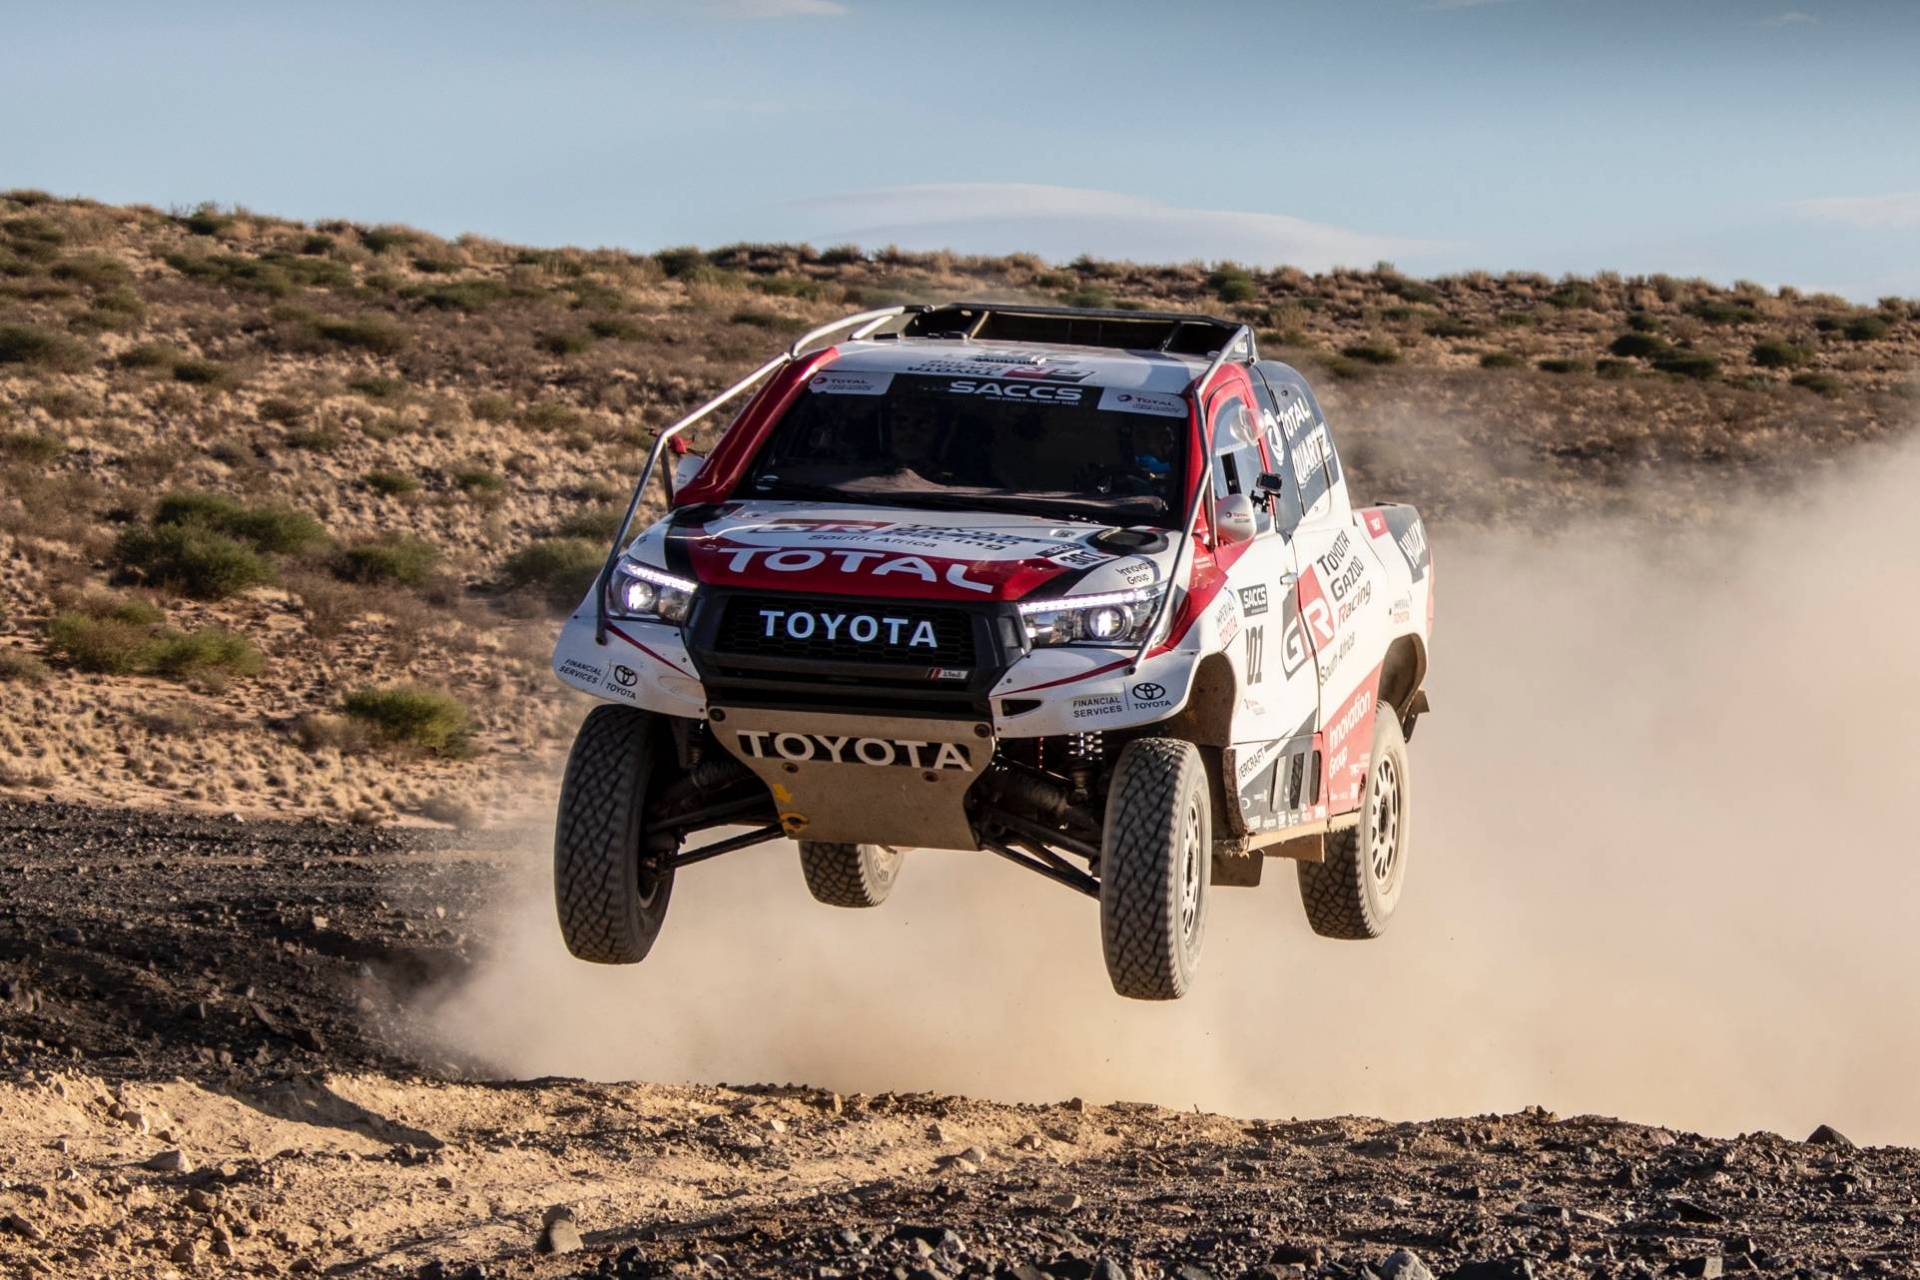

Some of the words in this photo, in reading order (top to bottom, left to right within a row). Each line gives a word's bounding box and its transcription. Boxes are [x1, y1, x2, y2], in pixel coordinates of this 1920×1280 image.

[949, 380, 1084, 401] SACCS
[1136, 396, 1175, 407] TOTAL
[1277, 397, 1311, 442] TOTAL
[1291, 421, 1332, 485] QUARTZ
[807, 534, 869, 542] South
[877, 537, 937, 548] Africa
[1316, 529, 1350, 576] TOYOTA
[717, 547, 994, 594] TOTAL
[1127, 573, 1150, 586] Group
[1330, 555, 1364, 602] GAZOO
[1243, 586, 1267, 609] SACCS
[1338, 580, 1371, 630] Racing
[759, 609, 939, 648] TOYOTA
[1281, 590, 1335, 677] GR
[559, 665, 599, 684] SERVICES
[564, 659, 602, 676] FINANCIAL
[606, 682, 637, 700] TOYOTA
[1073, 696, 1121, 708] FINANCIAL
[1134, 699, 1172, 710] TOYOTA
[1073, 704, 1123, 718] SERVICES
[1329, 690, 1371, 753] Innovation
[736, 729, 974, 772] TOYOTA
[1329, 746, 1348, 780] Group
